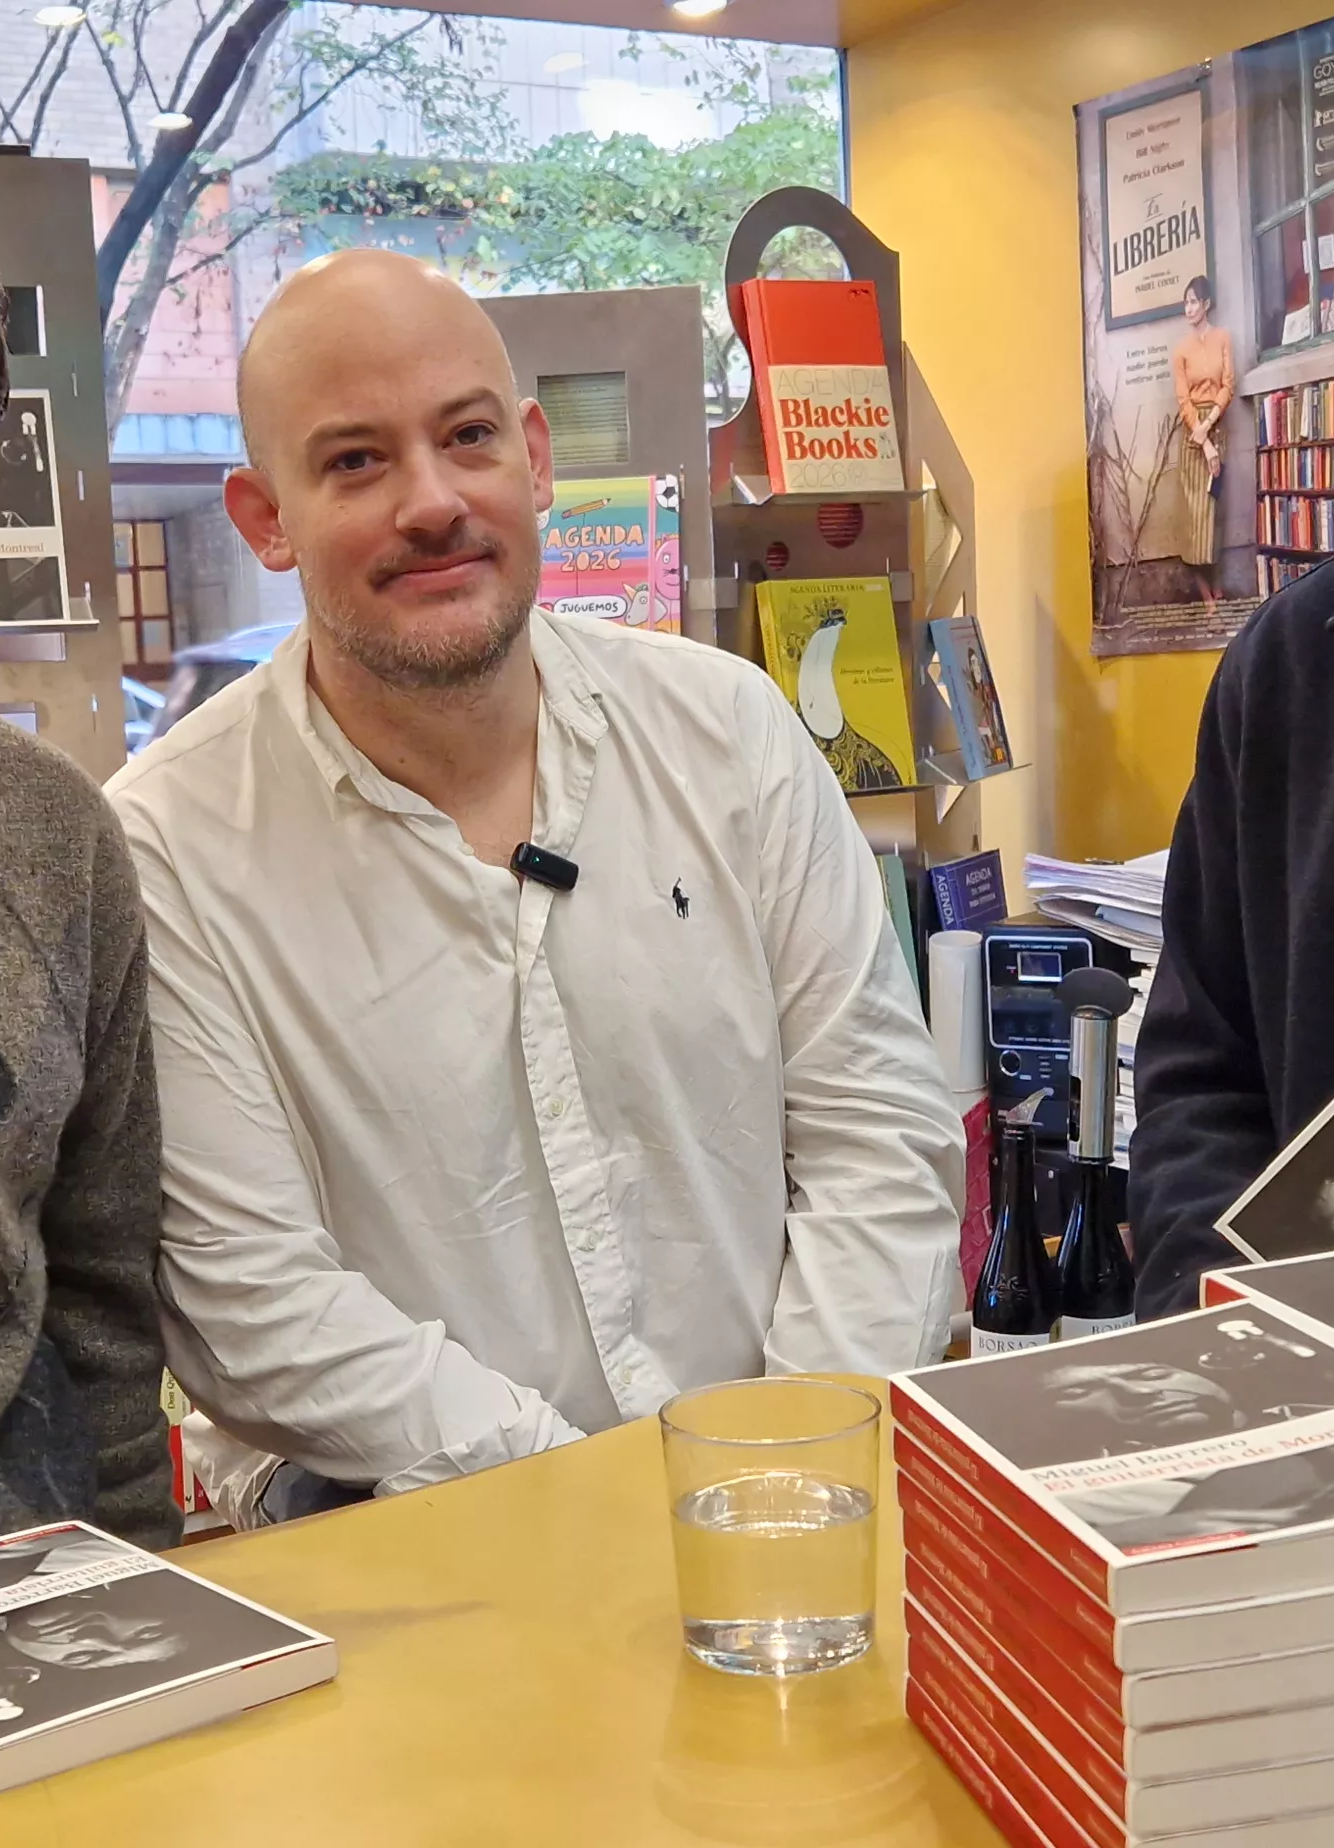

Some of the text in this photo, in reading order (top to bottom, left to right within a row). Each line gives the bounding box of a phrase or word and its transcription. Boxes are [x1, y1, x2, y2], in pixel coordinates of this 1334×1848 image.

[1113, 201, 1201, 276] LIBRERÍA
[777, 368, 886, 396] AGENDA
[779, 397, 890, 428] Blackie
[783, 429, 879, 461] Books
[788, 462, 847, 489] 2026
[544, 524, 645, 550] AGENDA
[560, 548, 622, 573] 2026
[822, 583, 865, 594] LITERARIA
[559, 602, 619, 614] JUGUEMOS
[935, 874, 955, 926] AGENDA
[1031, 1438, 1248, 1482] Miguel Barrero
[1043, 1477, 1075, 1493] El
[1081, 1452, 1236, 1489] guitarrista
[1242, 1443, 1273, 1459] de
[4, 1558, 119, 1597] guitarrista
[82, 1560, 160, 1589] Miguel
